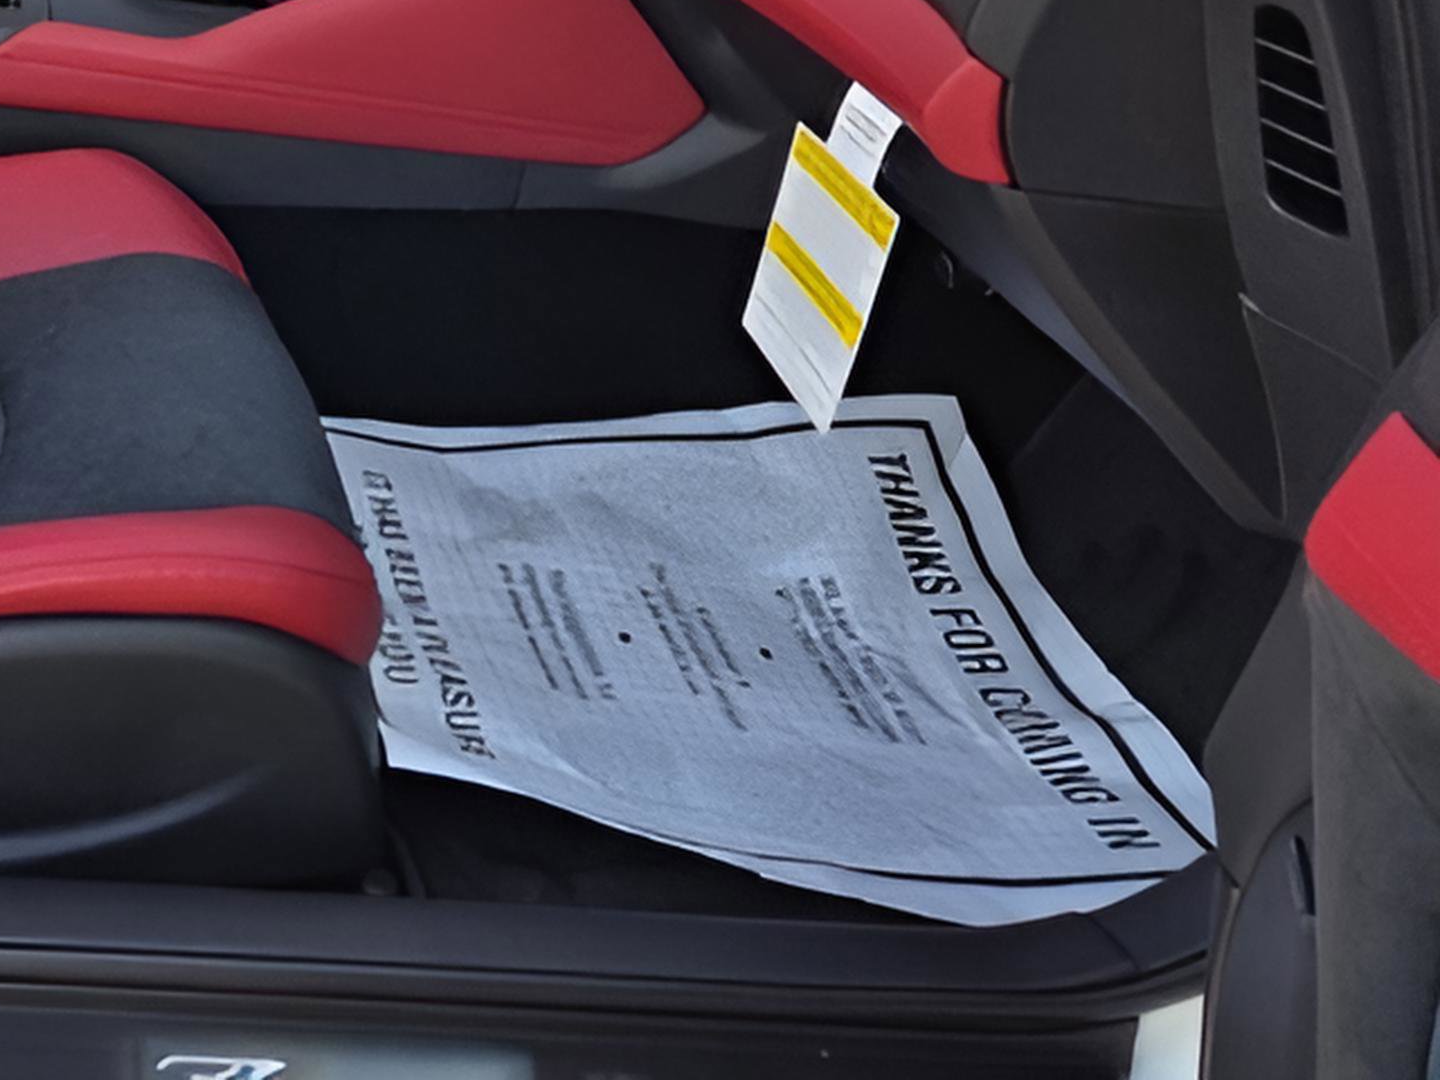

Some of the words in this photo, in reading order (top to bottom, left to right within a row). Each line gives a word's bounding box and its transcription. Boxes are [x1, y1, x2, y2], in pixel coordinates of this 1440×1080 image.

[867, 453, 962, 594] THANKS
[929, 607, 1009, 674] FOR
[979, 687, 1120, 803] COMING
[1086, 817, 1160, 849] IN
